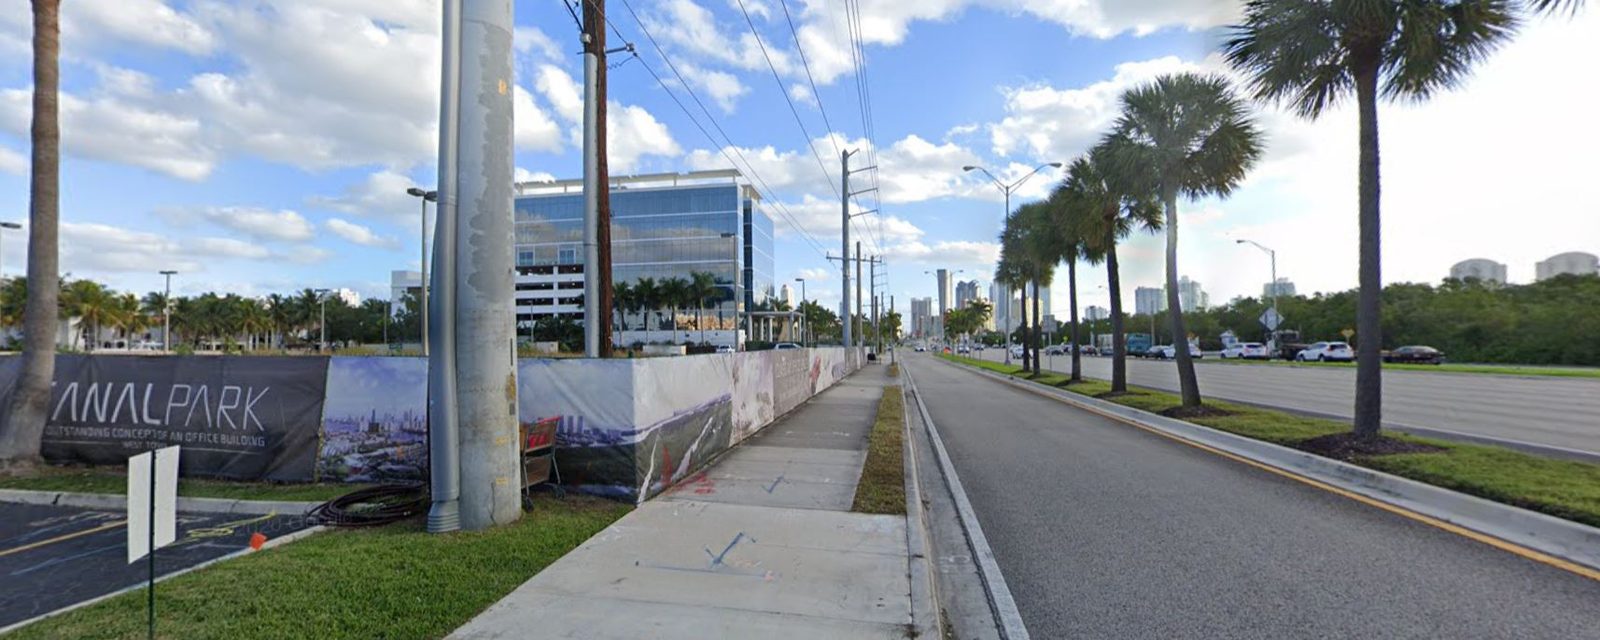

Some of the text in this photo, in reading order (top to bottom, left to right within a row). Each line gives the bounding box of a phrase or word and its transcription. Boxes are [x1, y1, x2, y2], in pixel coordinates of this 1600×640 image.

[51, 382, 270, 431] ANALPARK
[169, 431, 183, 441] AN
[185, 432, 219, 443] OFFICE
[221, 434, 266, 447] BUILDING
